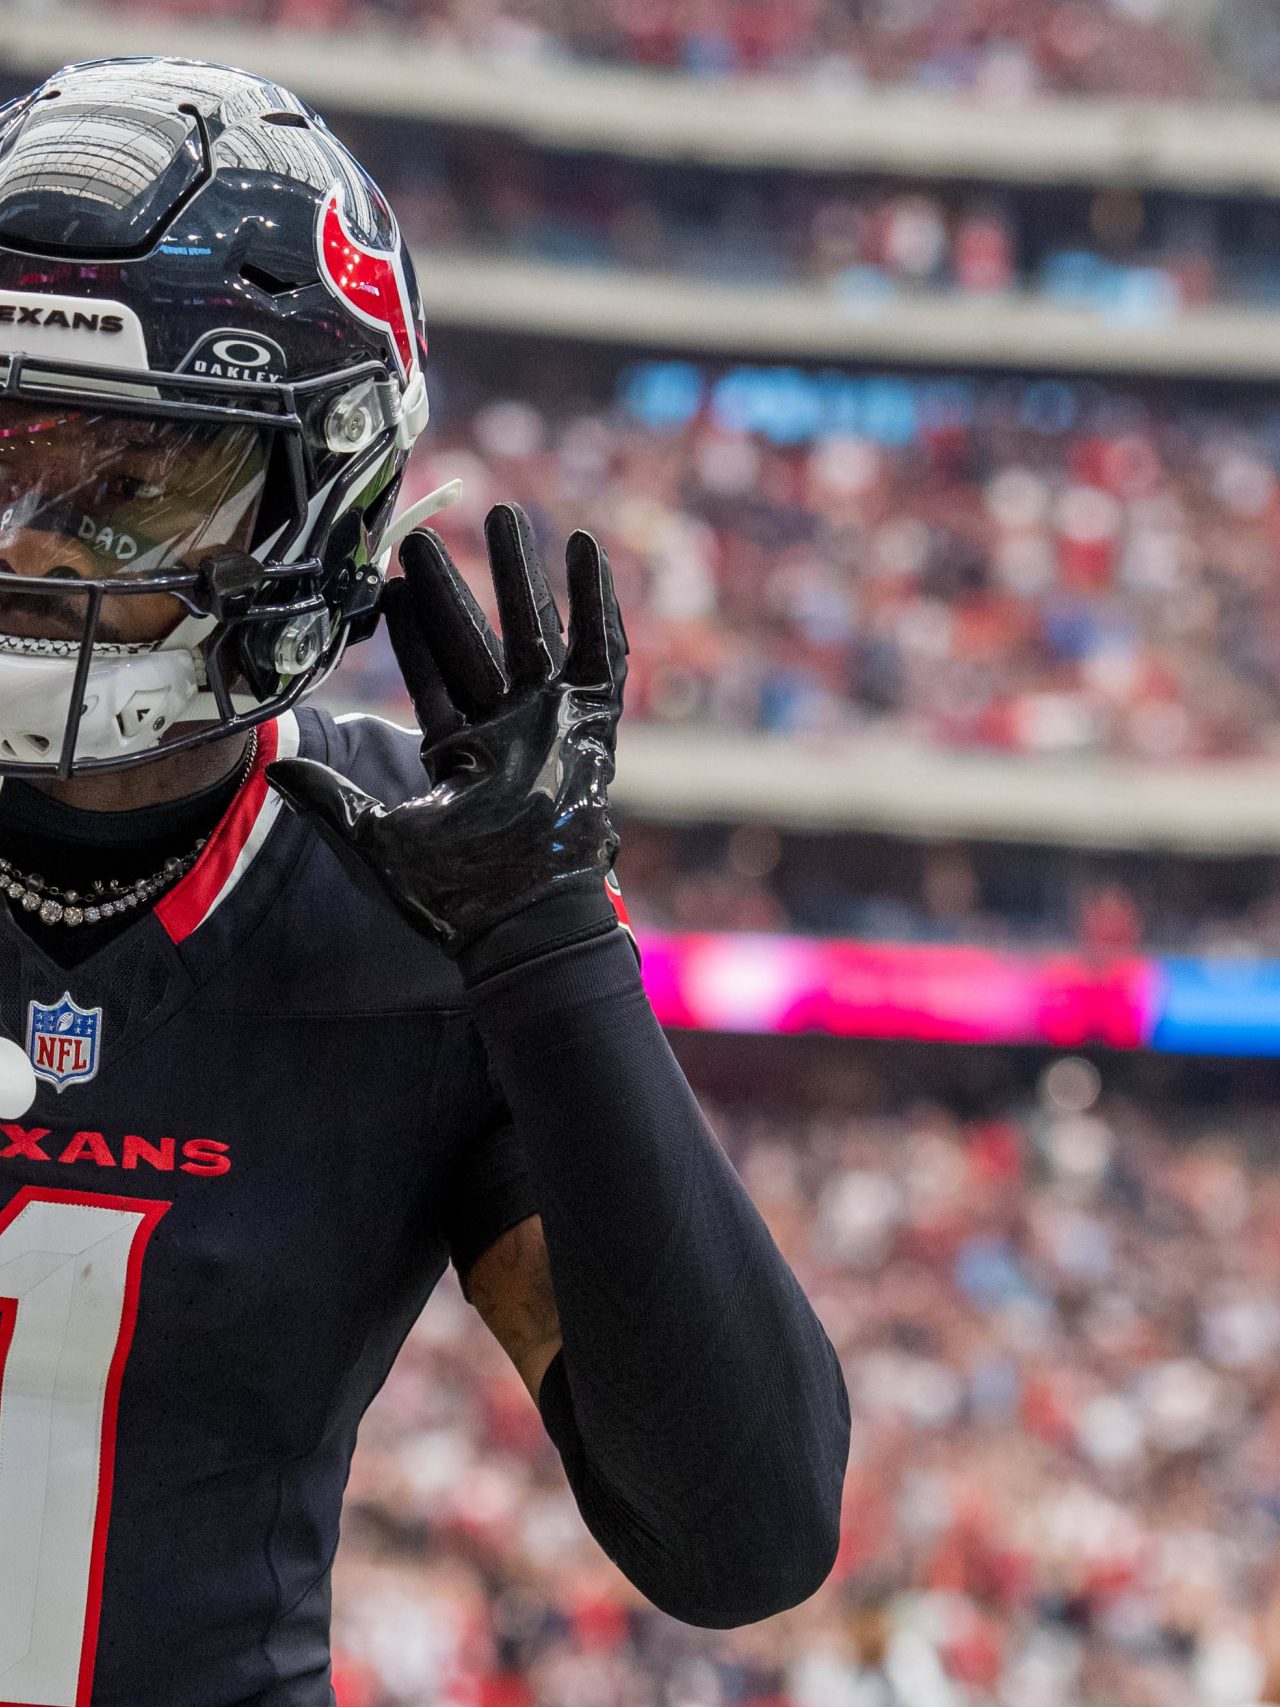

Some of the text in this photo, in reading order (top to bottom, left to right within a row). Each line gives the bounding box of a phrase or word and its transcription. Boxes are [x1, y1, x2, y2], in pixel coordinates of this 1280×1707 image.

[194, 360, 279, 383] OAKLEY
[78, 515, 137, 560] DAD
[37, 1036, 87, 1073] NFL
